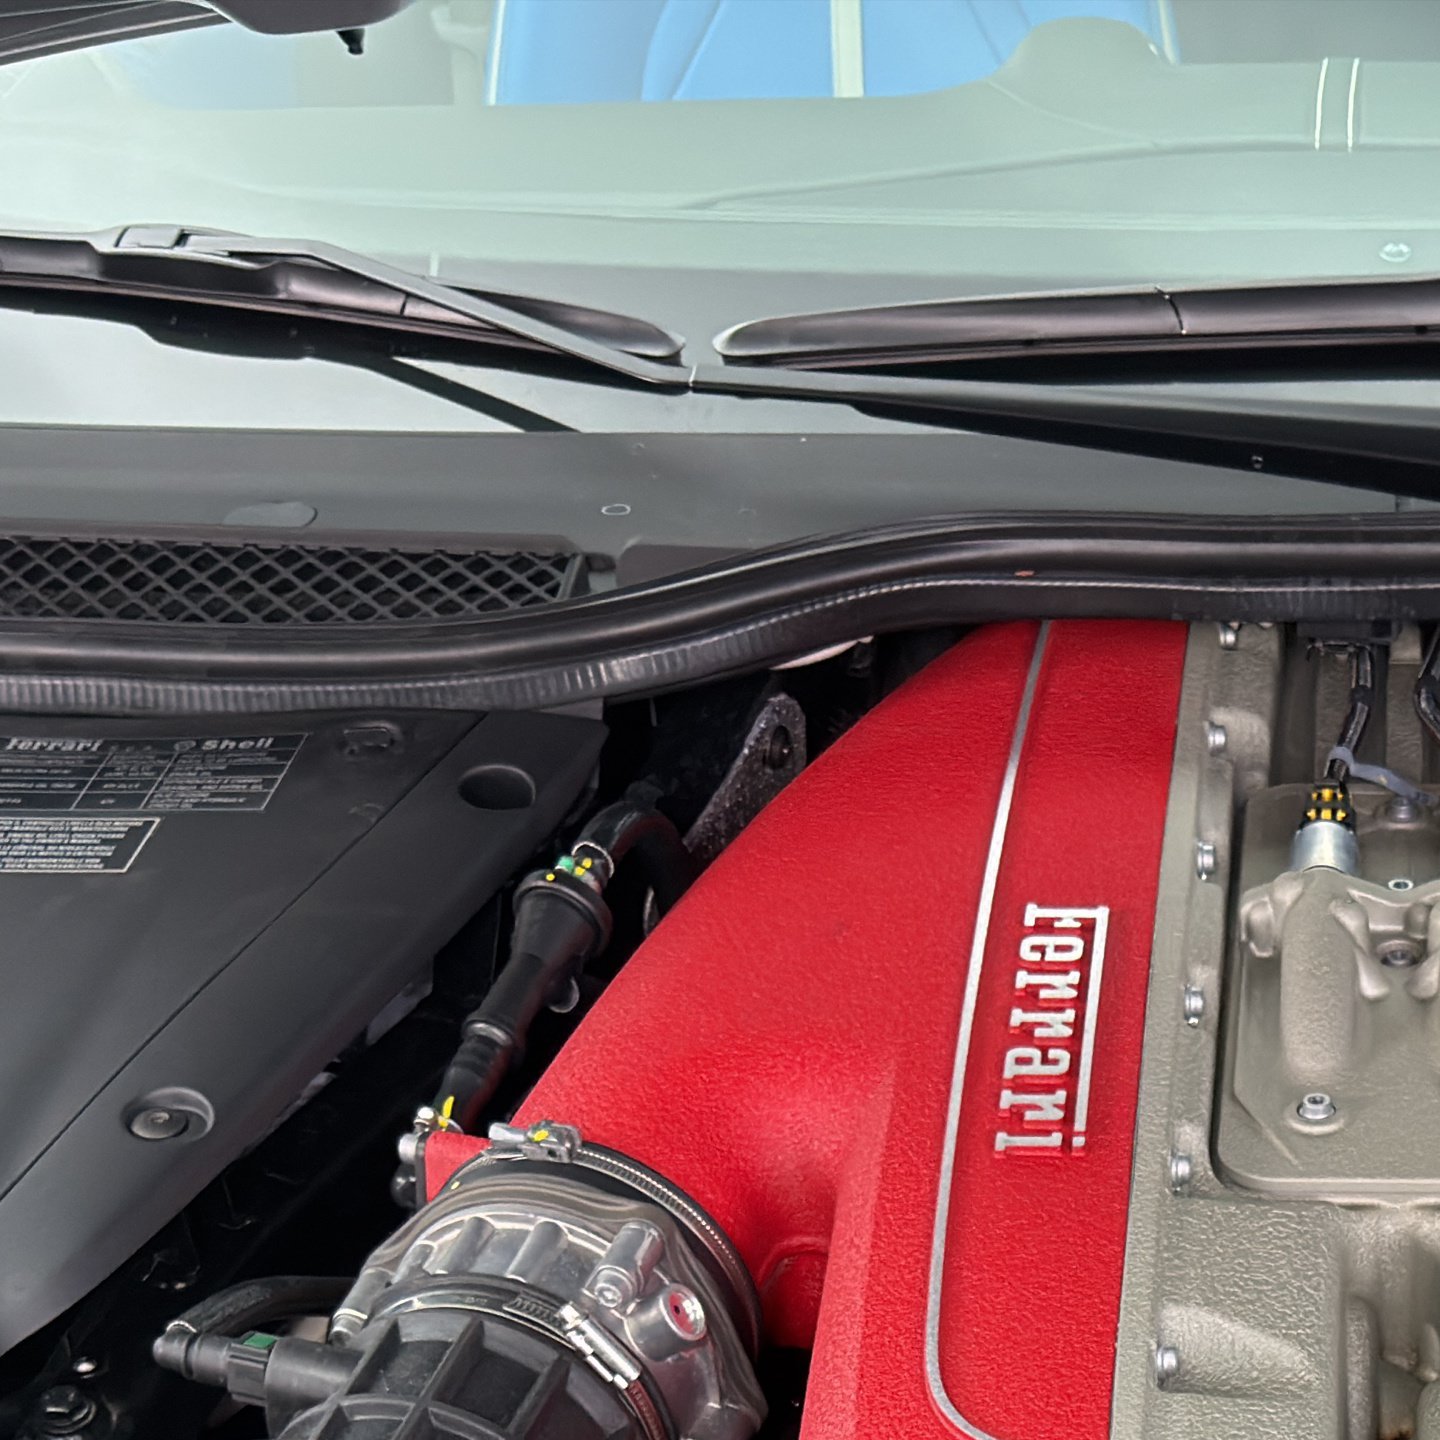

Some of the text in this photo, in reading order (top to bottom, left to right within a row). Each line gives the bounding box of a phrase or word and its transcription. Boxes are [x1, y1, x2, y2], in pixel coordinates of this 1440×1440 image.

[5, 738, 102, 752] Ferrari
[201, 738, 272, 750] Shell
[994, 903, 1110, 1151] Ferrari
